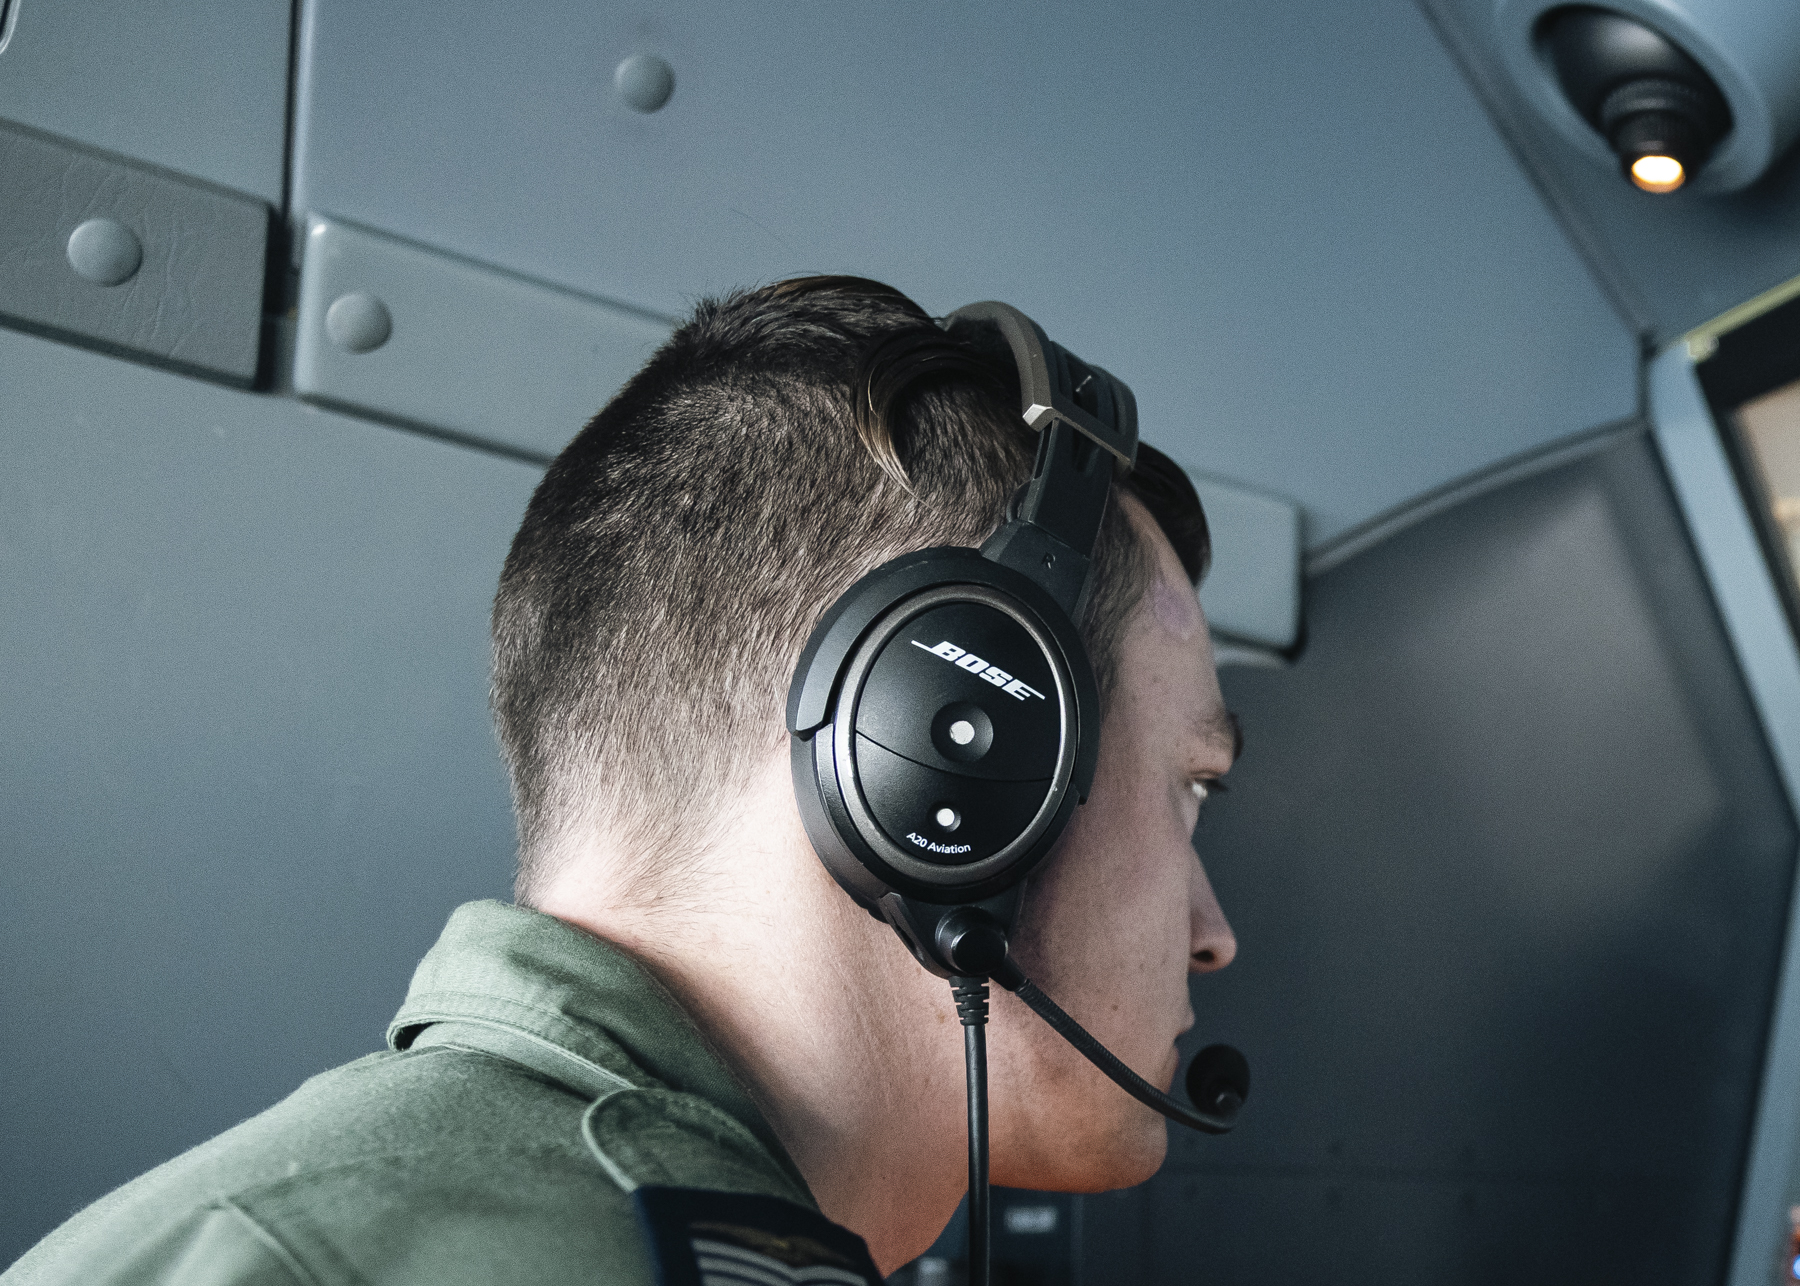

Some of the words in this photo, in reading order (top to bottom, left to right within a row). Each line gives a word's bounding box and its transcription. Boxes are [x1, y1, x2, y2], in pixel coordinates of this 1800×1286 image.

[911, 640, 1045, 701] BOSE
[906, 832, 928, 848] A20
[927, 842, 972, 854] Aviation
